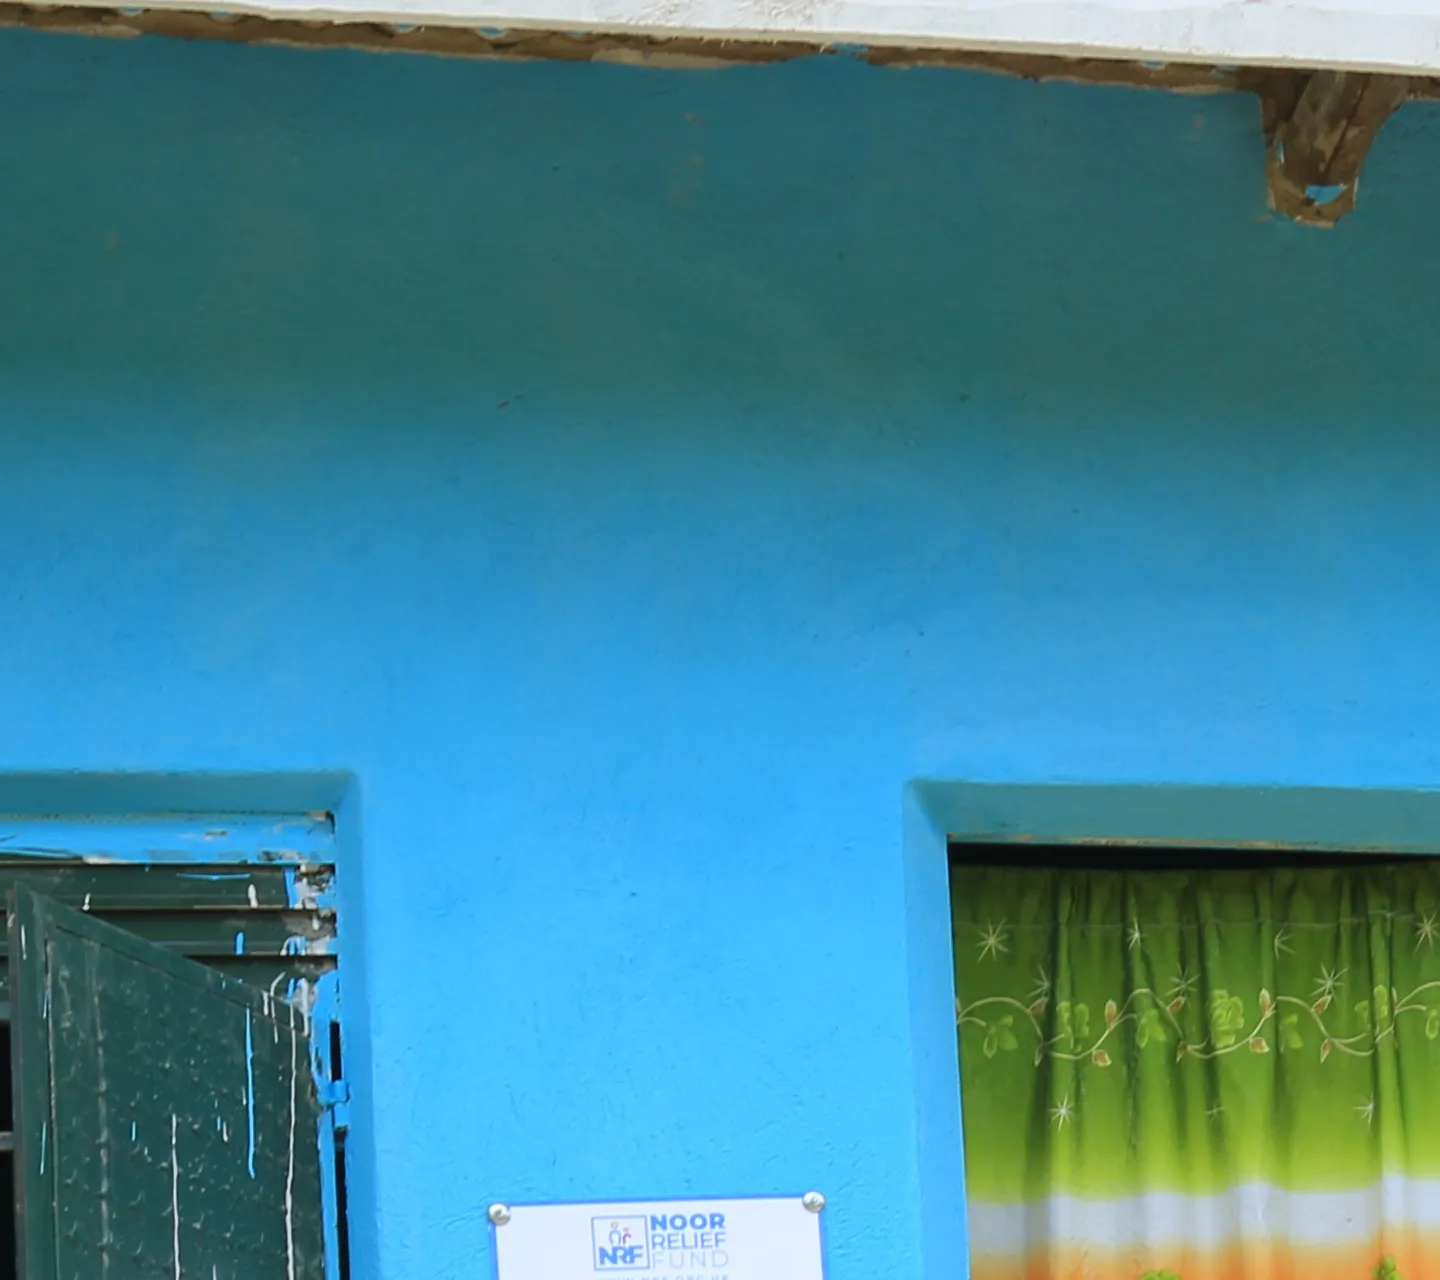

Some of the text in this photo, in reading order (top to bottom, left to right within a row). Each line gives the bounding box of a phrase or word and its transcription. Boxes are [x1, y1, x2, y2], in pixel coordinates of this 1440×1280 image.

[649, 1213, 726, 1230] NOOR
[650, 1230, 727, 1250] RELIEF
[599, 1245, 643, 1265] NRF
[651, 1249, 730, 1270] FUND
